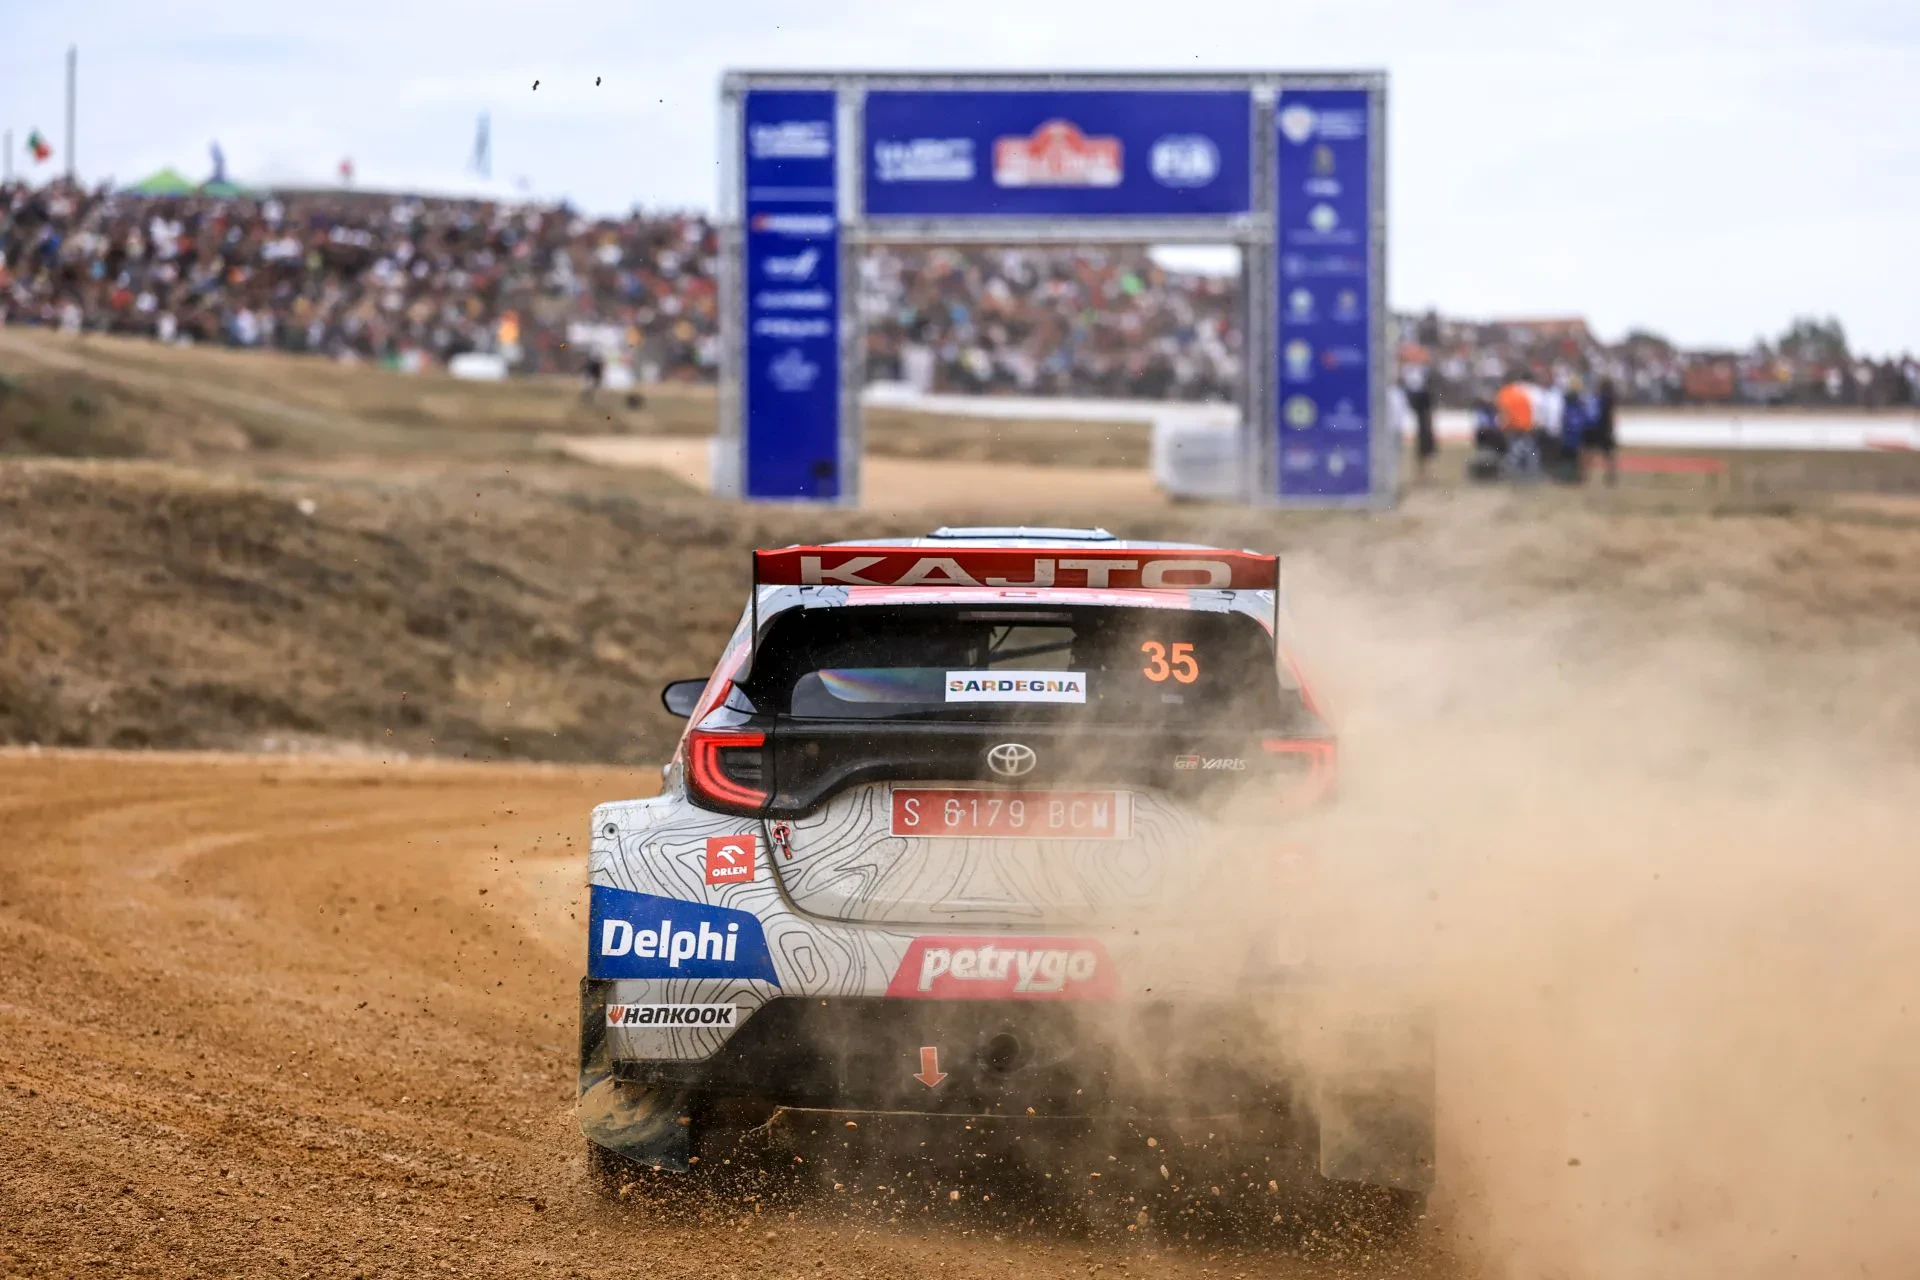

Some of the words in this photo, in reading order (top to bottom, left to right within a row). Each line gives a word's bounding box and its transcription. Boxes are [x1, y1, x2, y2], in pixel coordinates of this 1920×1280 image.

[800, 556, 1232, 588] KAJTO
[1141, 640, 1199, 684] 35
[950, 680, 1080, 693] SARDEGNA
[1202, 758, 1246, 770] YARIS
[904, 798, 920, 826] S
[944, 799, 1025, 828] 6179
[712, 866, 748, 877] ORLEN
[602, 919, 739, 968] Delphi
[917, 944, 1097, 993] petrygo
